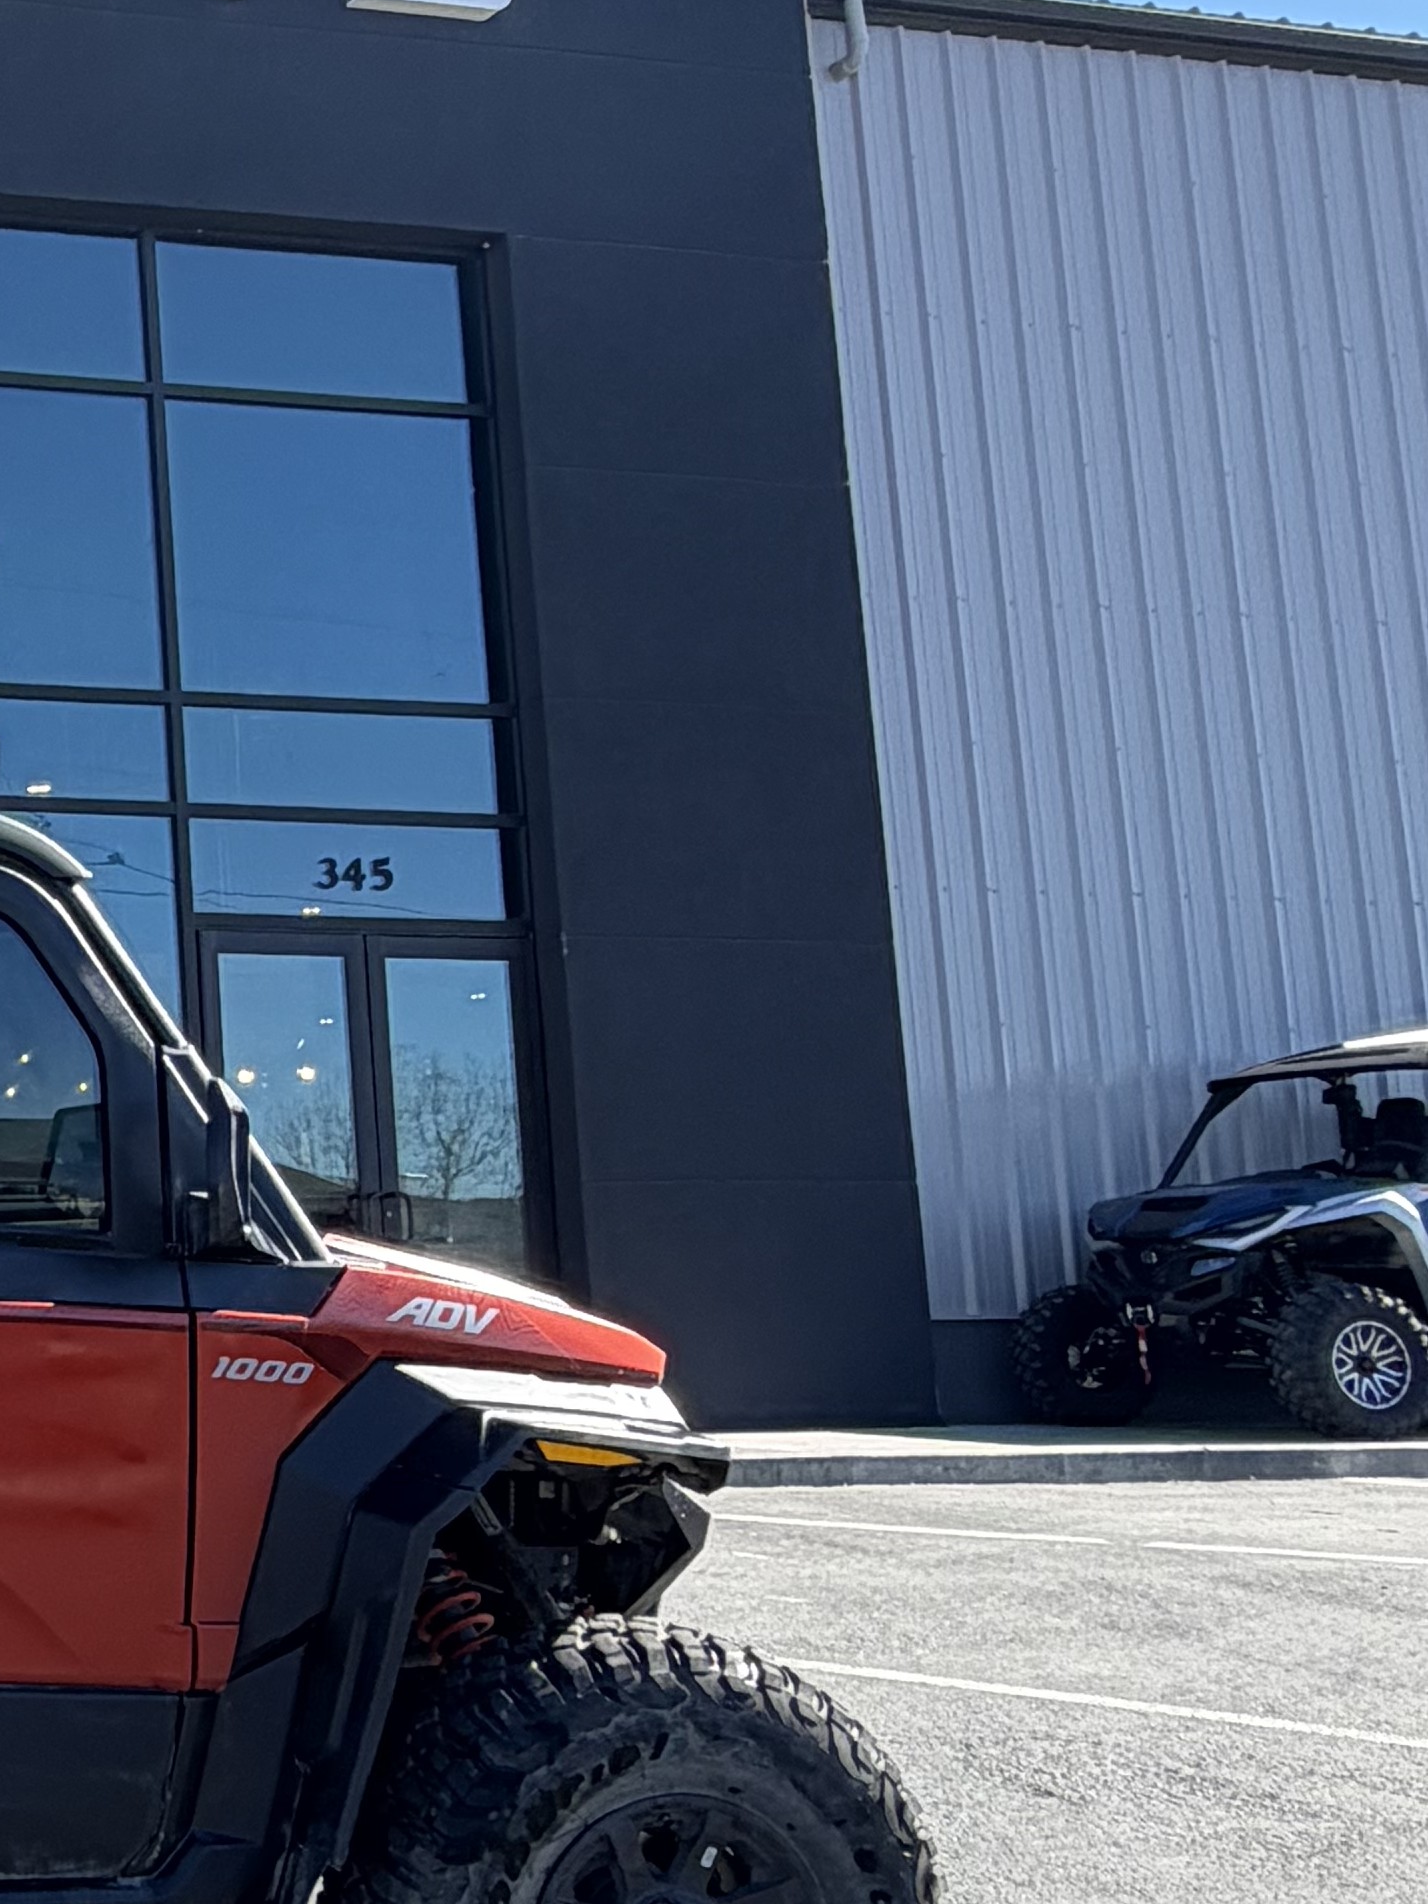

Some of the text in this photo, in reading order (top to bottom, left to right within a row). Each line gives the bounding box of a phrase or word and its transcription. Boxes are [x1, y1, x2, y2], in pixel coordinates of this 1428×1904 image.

[312, 856, 394, 892] 345
[386, 1296, 500, 1335] ADV
[211, 1355, 316, 1385] 1000
